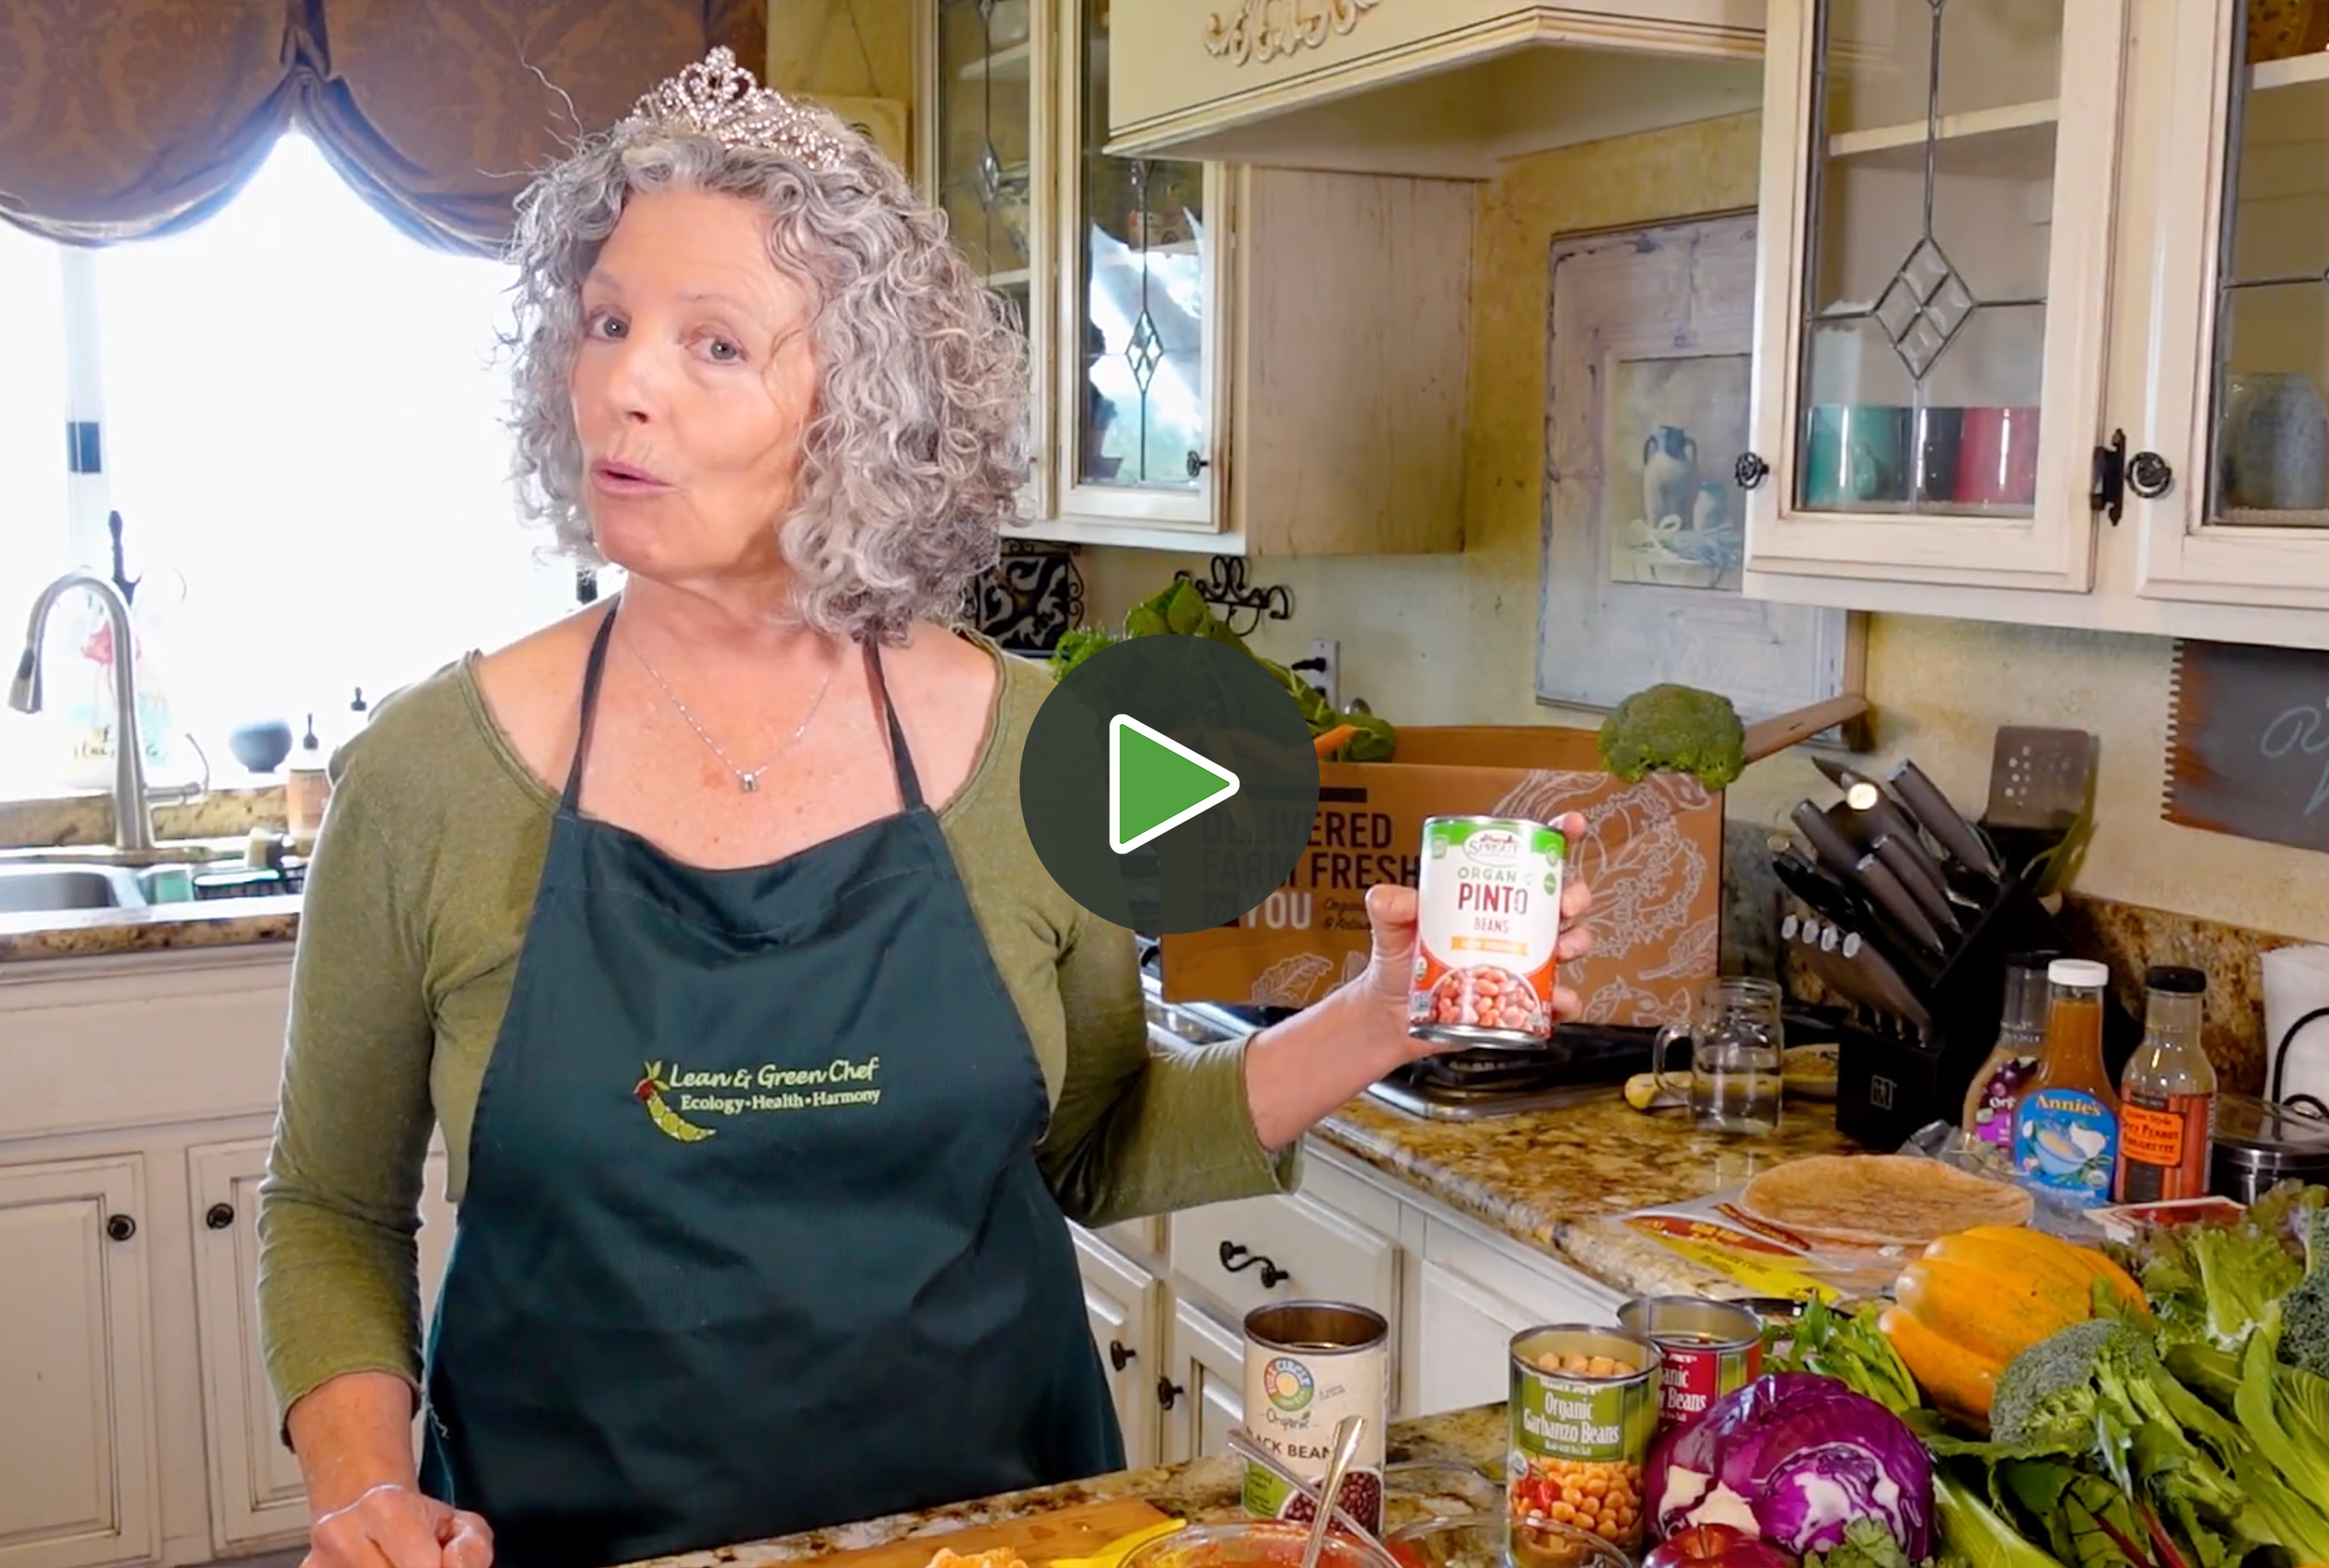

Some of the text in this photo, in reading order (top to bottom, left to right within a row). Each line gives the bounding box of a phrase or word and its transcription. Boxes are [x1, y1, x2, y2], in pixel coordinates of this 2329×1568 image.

[1202, 850, 1420, 889] FARM FRESH
[1239, 891, 1313, 930] YOU
[1458, 882, 1528, 915] PINTO
[1474, 918, 1509, 934] BEANS
[669, 1057, 879, 1089] Lean & Green Chef
[1546, 1391, 1594, 1422] Organic
[1668, 1386, 1707, 1412] Beans
[1266, 1408, 1311, 1431] Organic
[1524, 1408, 1620, 1444] Garbanzo Beans
[1287, 1444, 1330, 1459] BEAN
